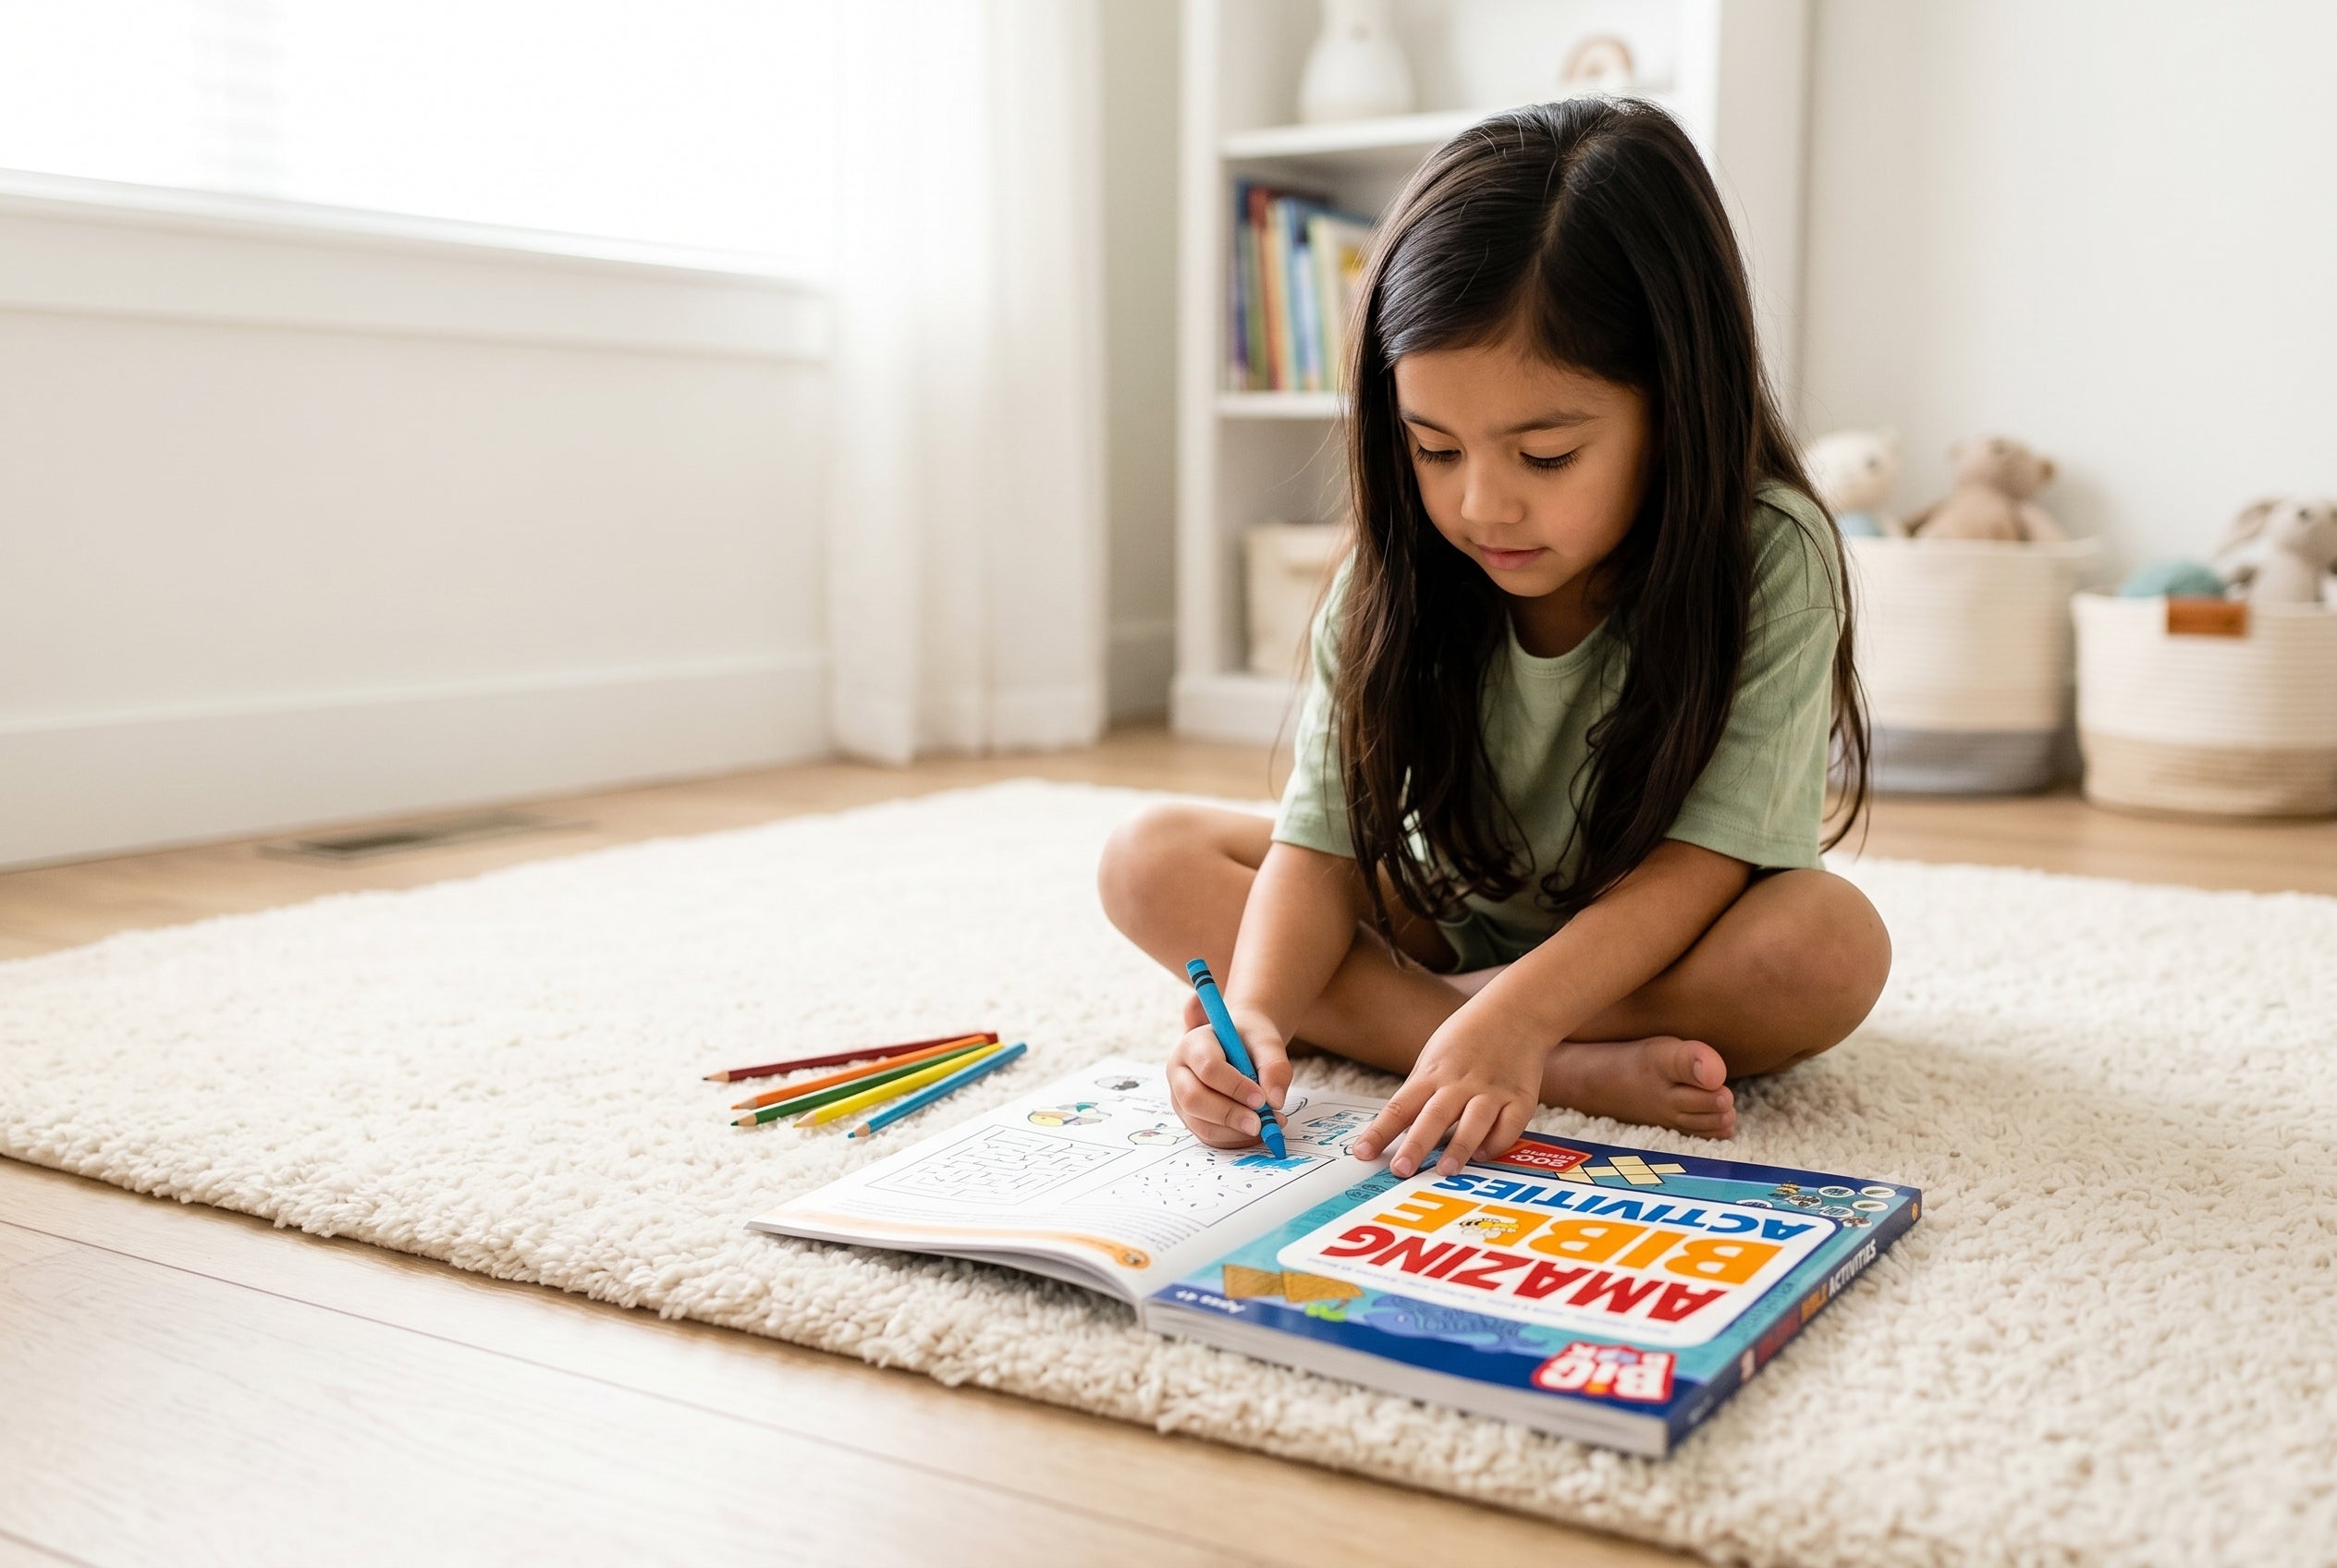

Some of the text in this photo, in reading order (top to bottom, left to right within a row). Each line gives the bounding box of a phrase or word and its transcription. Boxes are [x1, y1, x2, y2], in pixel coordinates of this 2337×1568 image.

[1373, 1190, 1783, 1285] BIBLE
[1432, 1174, 1817, 1241] ACTIVITIES
[1321, 1224, 1727, 1322] AMAZING
[1829, 1239, 1877, 1297] ACTIVITIES
